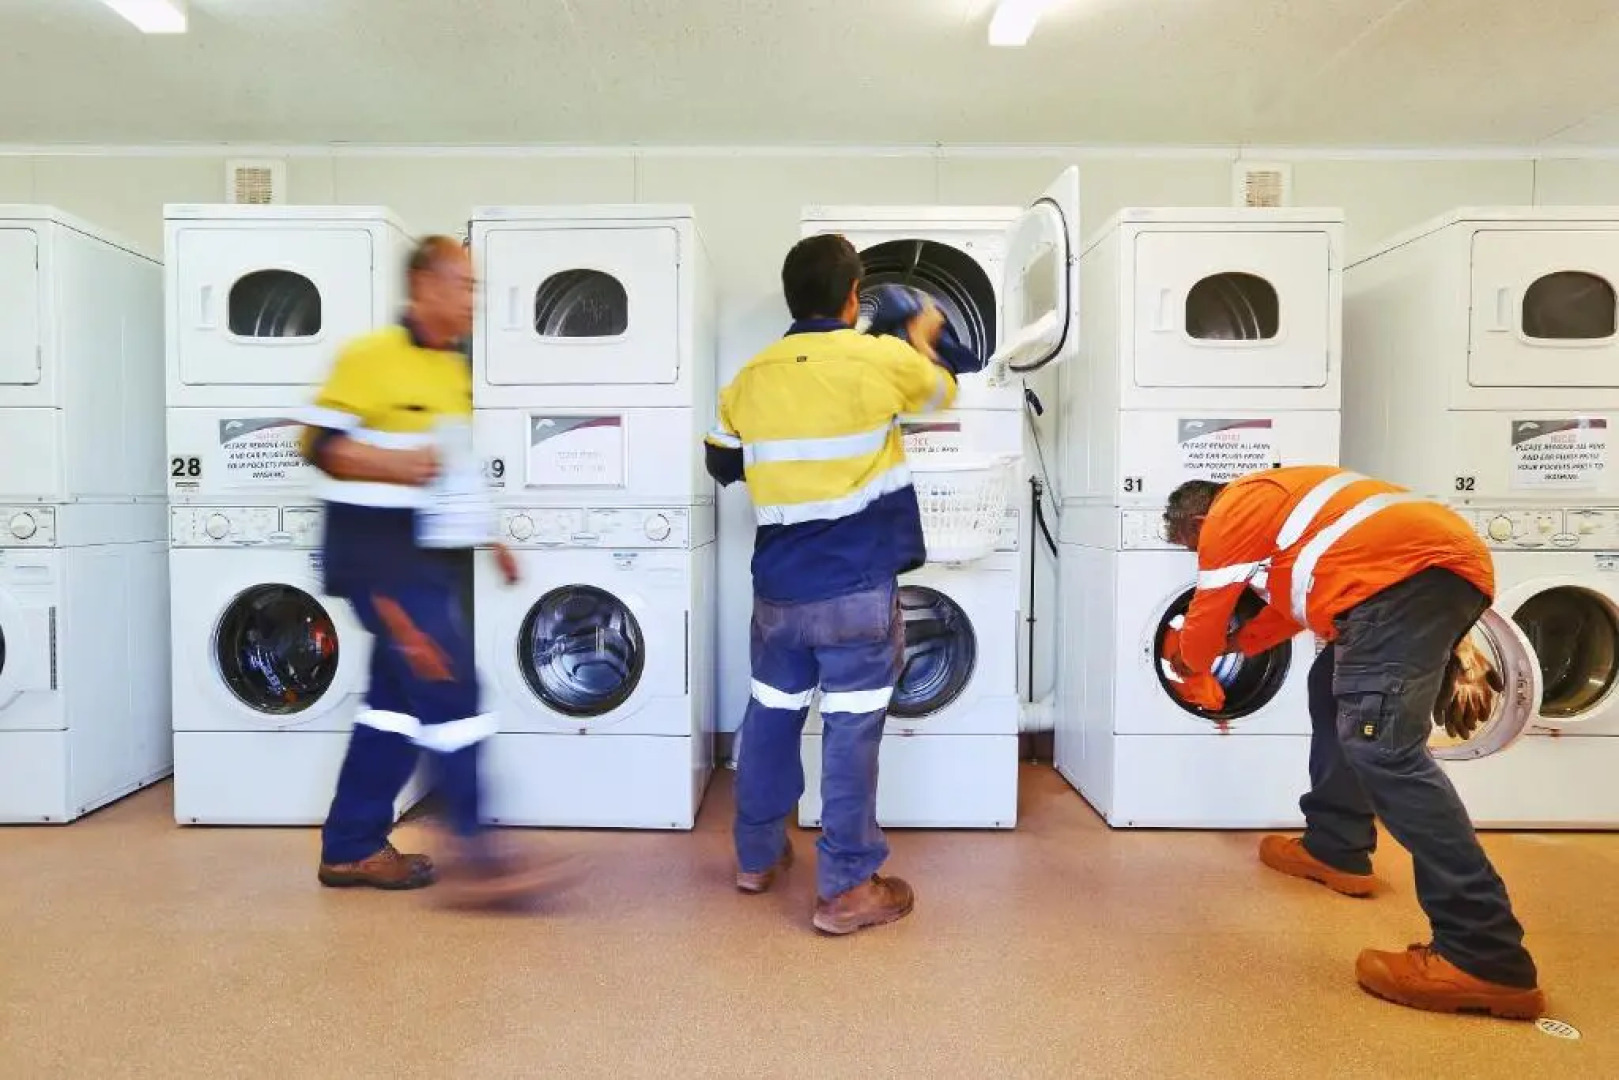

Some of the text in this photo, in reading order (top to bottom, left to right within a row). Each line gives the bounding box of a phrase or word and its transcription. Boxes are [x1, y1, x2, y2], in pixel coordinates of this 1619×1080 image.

[1209, 442, 1239, 450] REMOVE
[171, 457, 201, 476] 28
[1124, 478, 1143, 492] 31
[1455, 477, 1475, 491] 32
